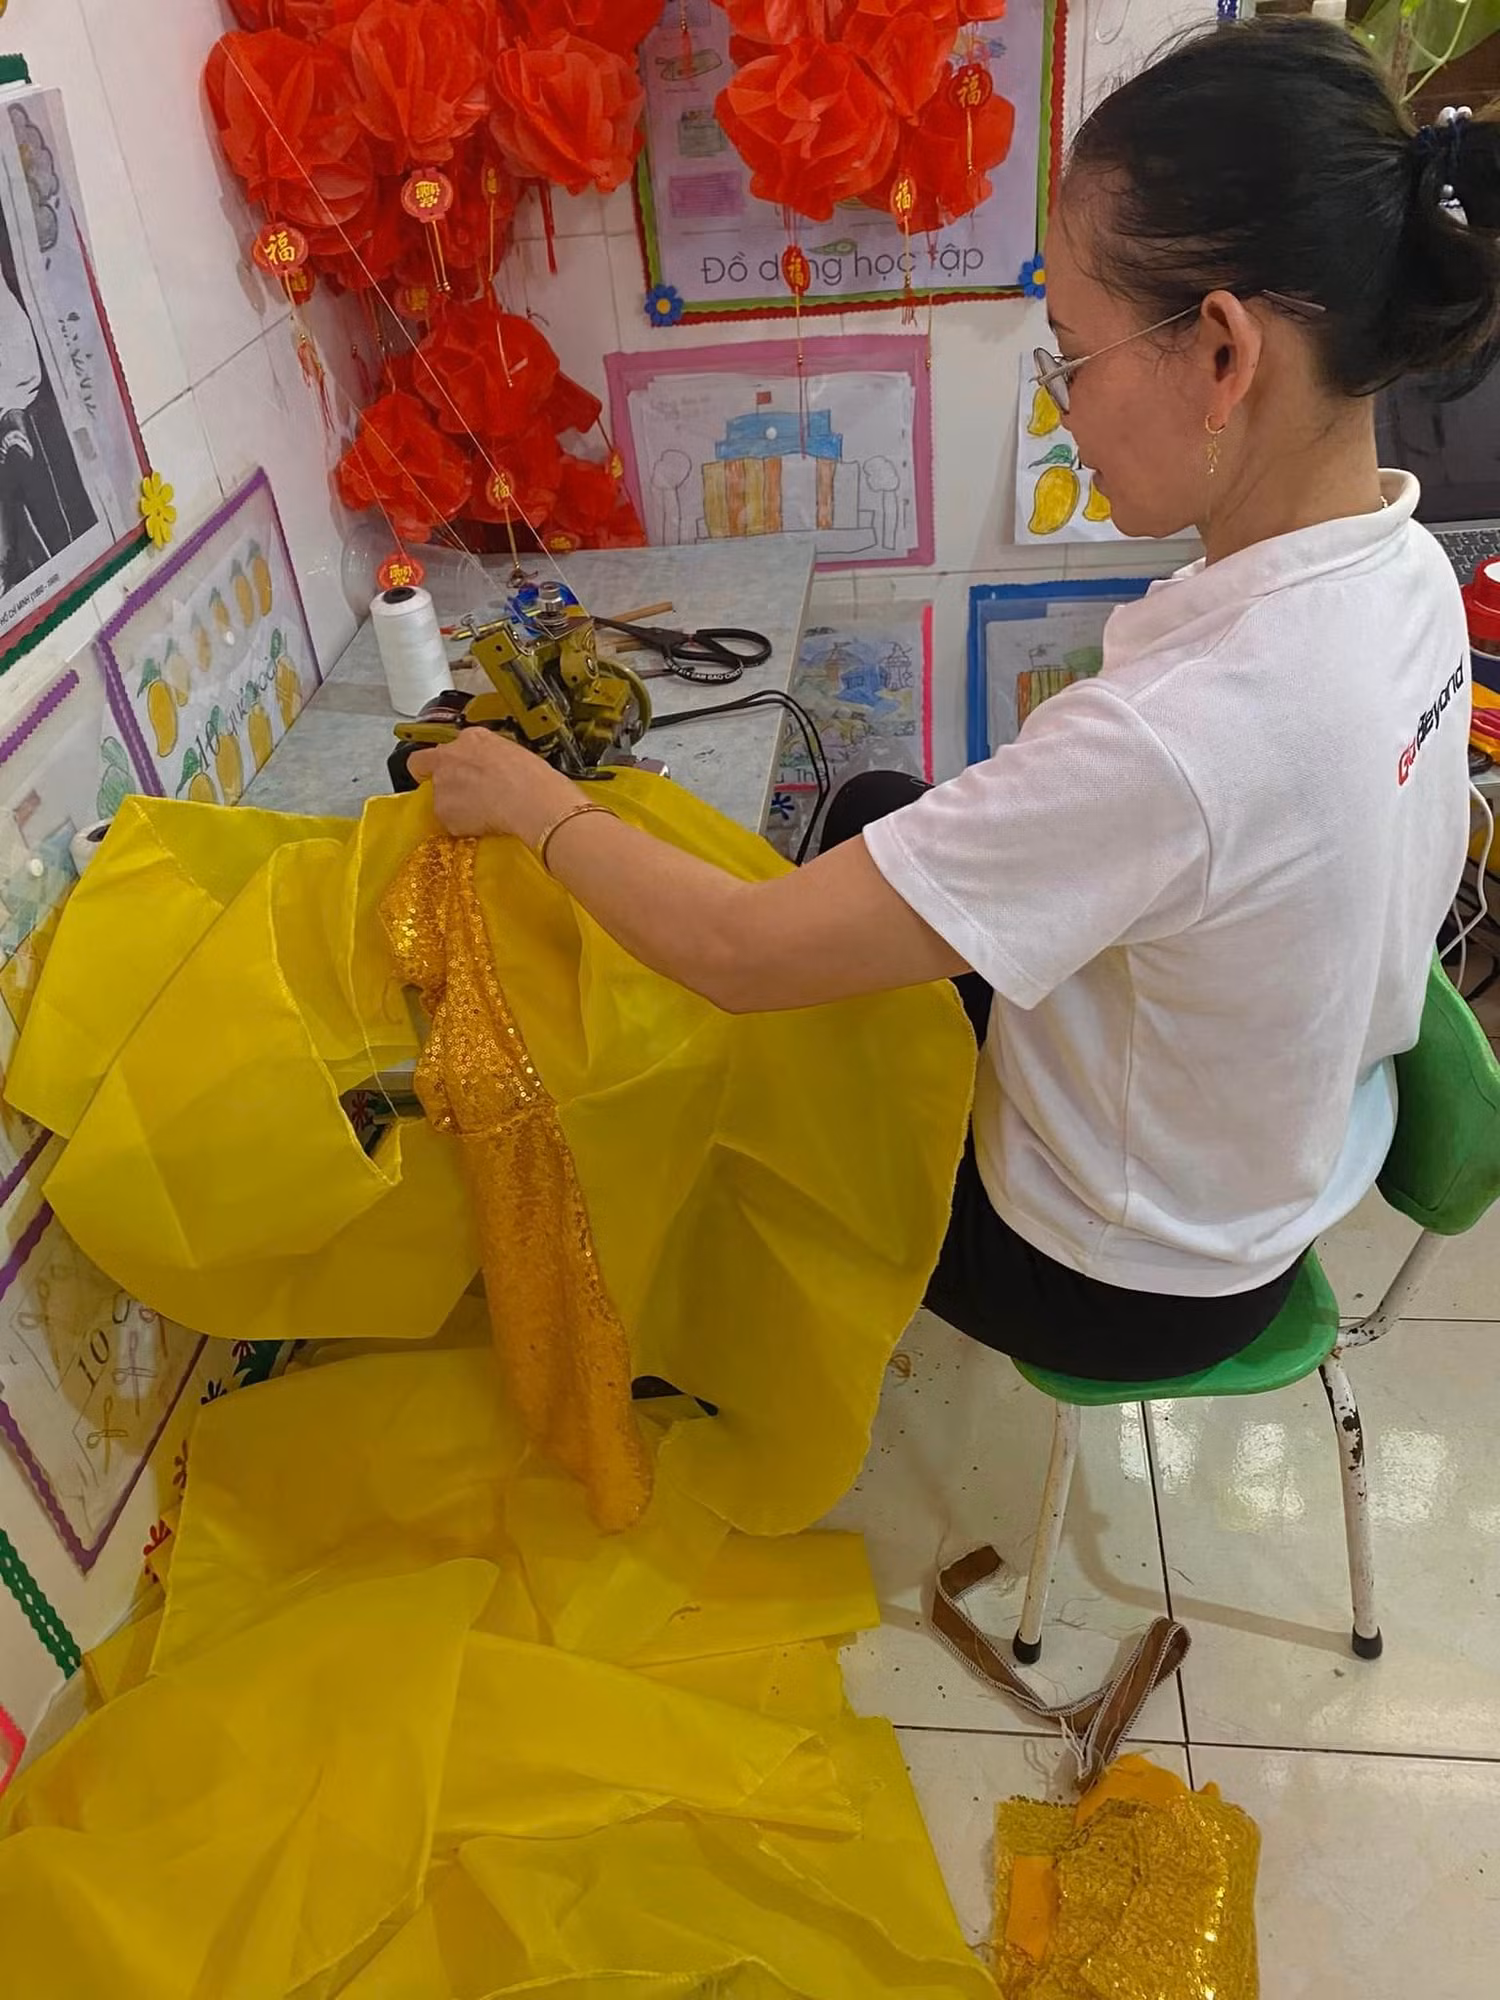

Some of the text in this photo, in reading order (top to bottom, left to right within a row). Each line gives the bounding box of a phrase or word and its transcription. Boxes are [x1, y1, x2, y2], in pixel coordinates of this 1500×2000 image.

[957, 73, 982, 107] 福
[895, 178, 912, 213] 福
[264, 231, 295, 265] 福
[701, 242, 984, 286] Đồ dng học ập
[79, 1327, 109, 1387] 10
